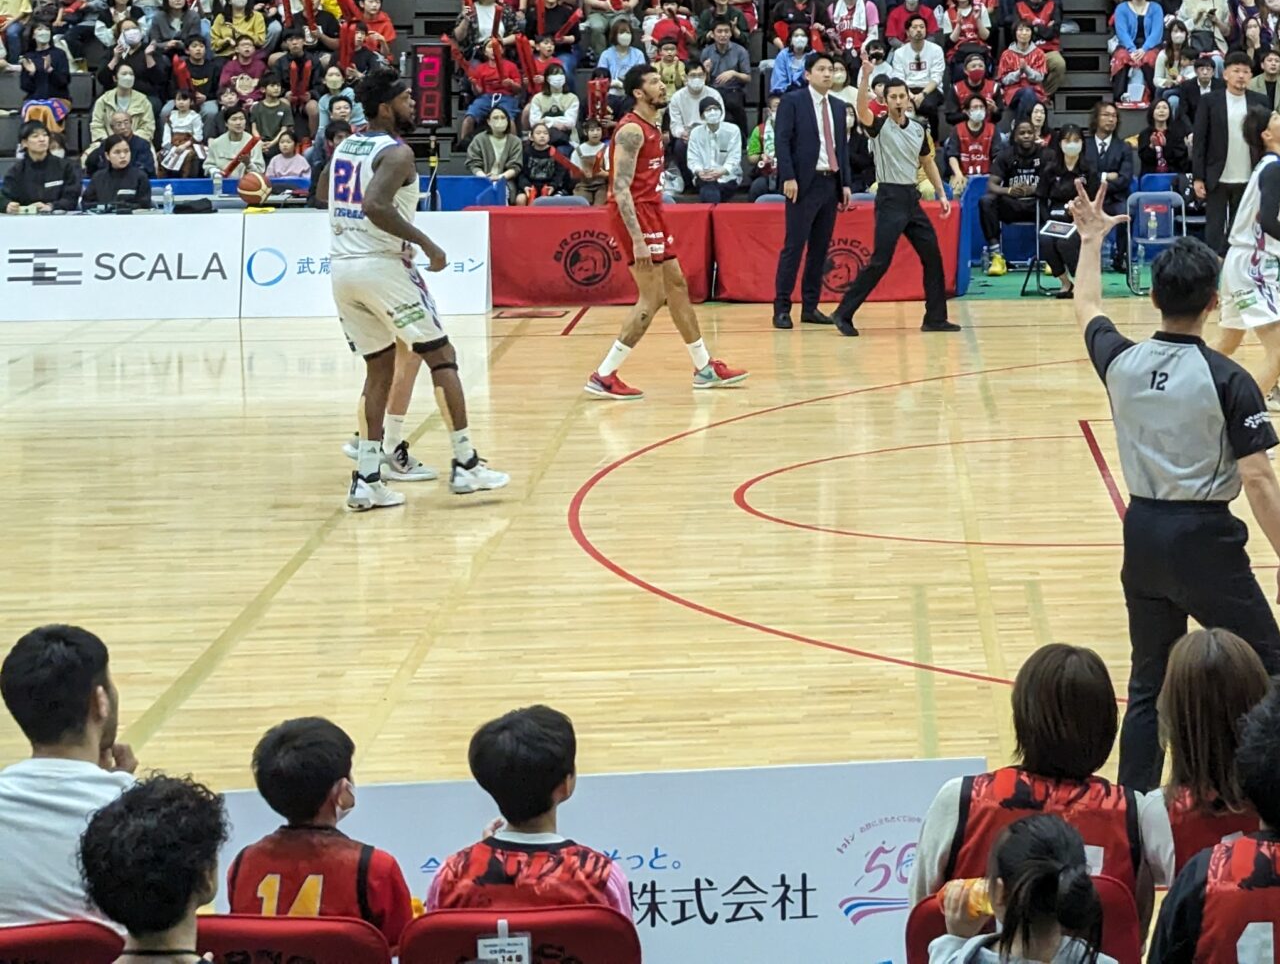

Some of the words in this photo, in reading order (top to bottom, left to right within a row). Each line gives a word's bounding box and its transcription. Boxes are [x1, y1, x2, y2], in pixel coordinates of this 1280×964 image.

[94, 251, 228, 281] SCALA
[1150, 369, 1169, 392] 12
[630, 872, 819, 928] 株式会社
